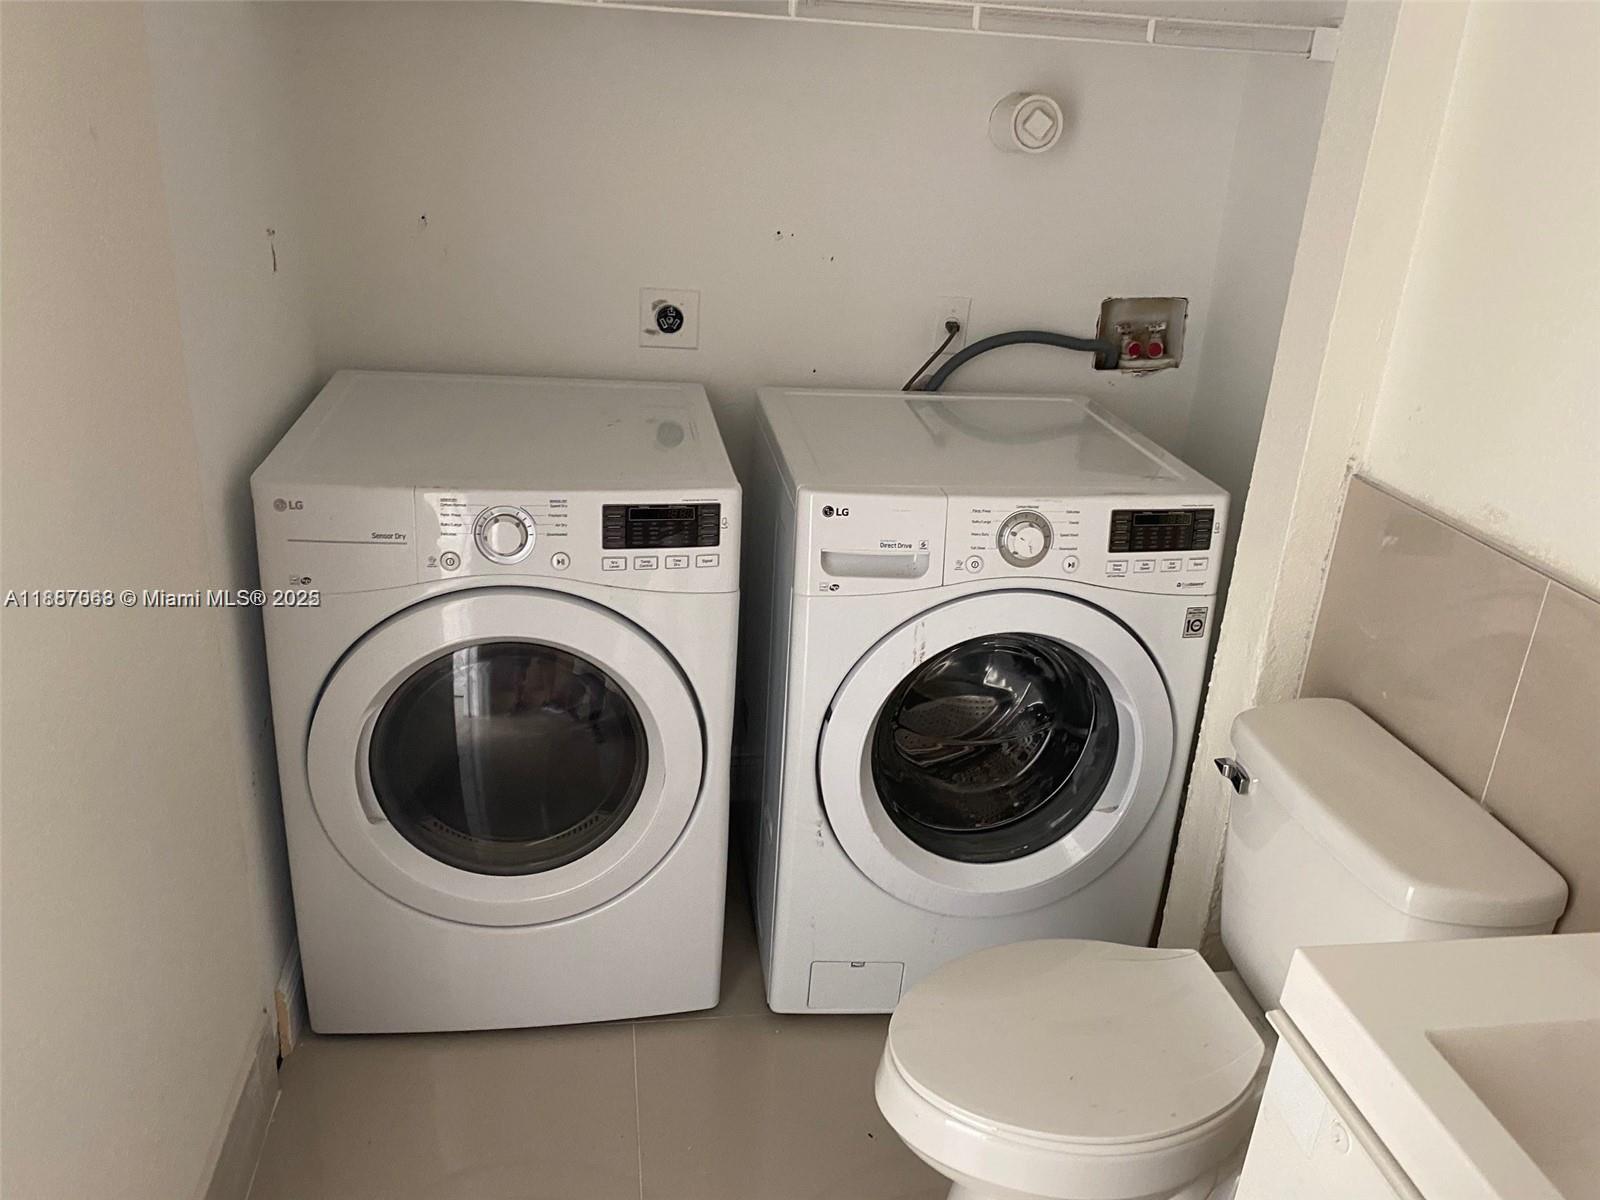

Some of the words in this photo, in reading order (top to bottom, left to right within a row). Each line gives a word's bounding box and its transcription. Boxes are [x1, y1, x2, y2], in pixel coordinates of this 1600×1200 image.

[288, 500, 304, 511] LG
[835, 507, 850, 517] LG
[371, 532, 394, 540] Sensor
[394, 532, 407, 541] Dry
